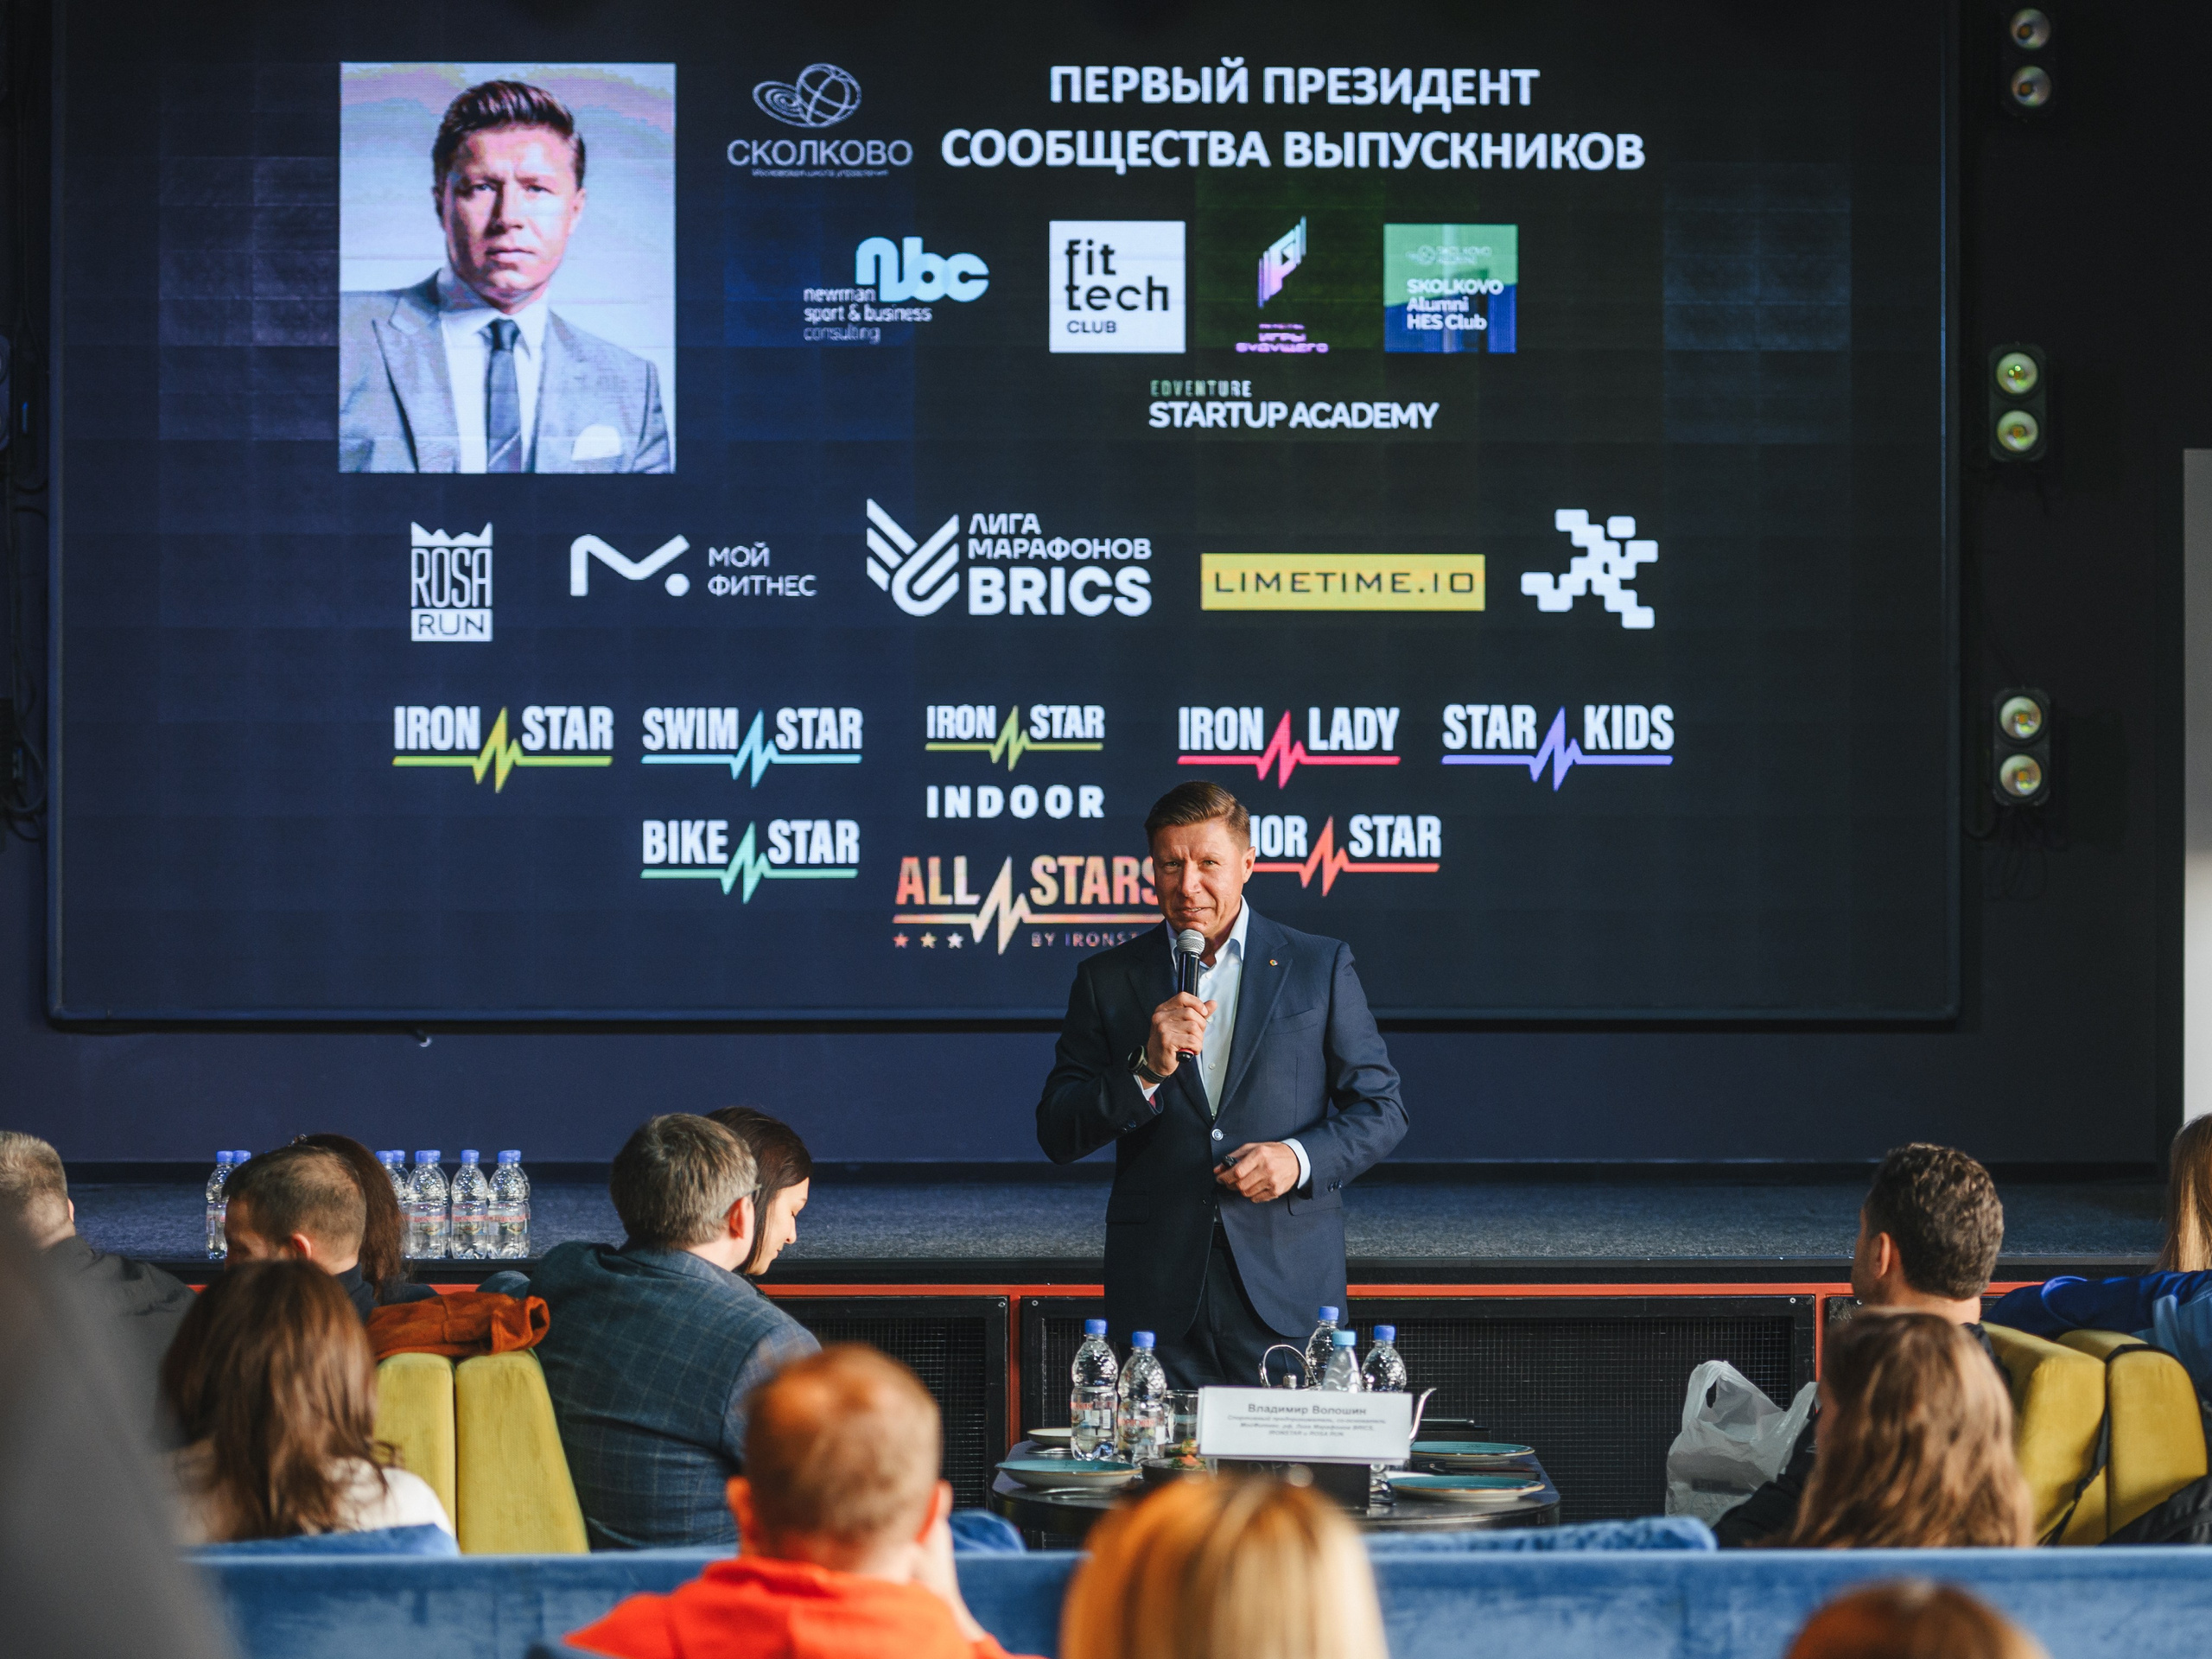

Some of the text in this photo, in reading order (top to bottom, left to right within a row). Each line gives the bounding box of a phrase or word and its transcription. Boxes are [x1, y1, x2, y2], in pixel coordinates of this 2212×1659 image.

[1050, 56, 1541, 114] ПЕРВЫЙ ПРЕЗИДЕНТ
[727, 139, 913, 167] СКОЛКОВО
[941, 128, 1646, 175] СООБЩЕСТВА ВЫПУСКНИКОВ
[1065, 238, 1117, 276] fit
[800, 286, 877, 303] newman
[1065, 276, 1170, 312] tech
[1406, 277, 1505, 296] SKOLKOVO
[800, 302, 933, 325] sport & business
[1406, 296, 1470, 312] Alumni
[1066, 320, 1118, 334] CLUB
[1406, 313, 1489, 330] HES Club
[1148, 379, 1252, 397] EDVENTURE
[1148, 401, 1440, 429] STARTUP ACADEMY
[968, 512, 1042, 536] ЛИГА
[709, 541, 770, 568] МОЙ
[968, 536, 1152, 562] МАРАФОНОВ
[410, 547, 492, 607] ROSA
[707, 574, 817, 597] ФИТНЕС
[968, 565, 1152, 617] BRICS
[1214, 571, 1475, 594] LIMETIME.IO
[417, 613, 485, 636] RUN
[394, 705, 613, 751] IRON STAR
[642, 706, 863, 751] SWIM STAR
[926, 704, 1105, 740] IRON STAR
[1178, 706, 1400, 751] IRON LADY
[1442, 704, 1675, 750] STAR KIDS
[926, 784, 1104, 819] INDOOR
[642, 819, 860, 864] BIKE STAR
[1249, 814, 1441, 858] IOR STAR
[895, 855, 1159, 906] ALL STARS
[1031, 932, 1139, 948] BY IRONS
[1248, 1403, 1367, 1416] Владимир Волошин
